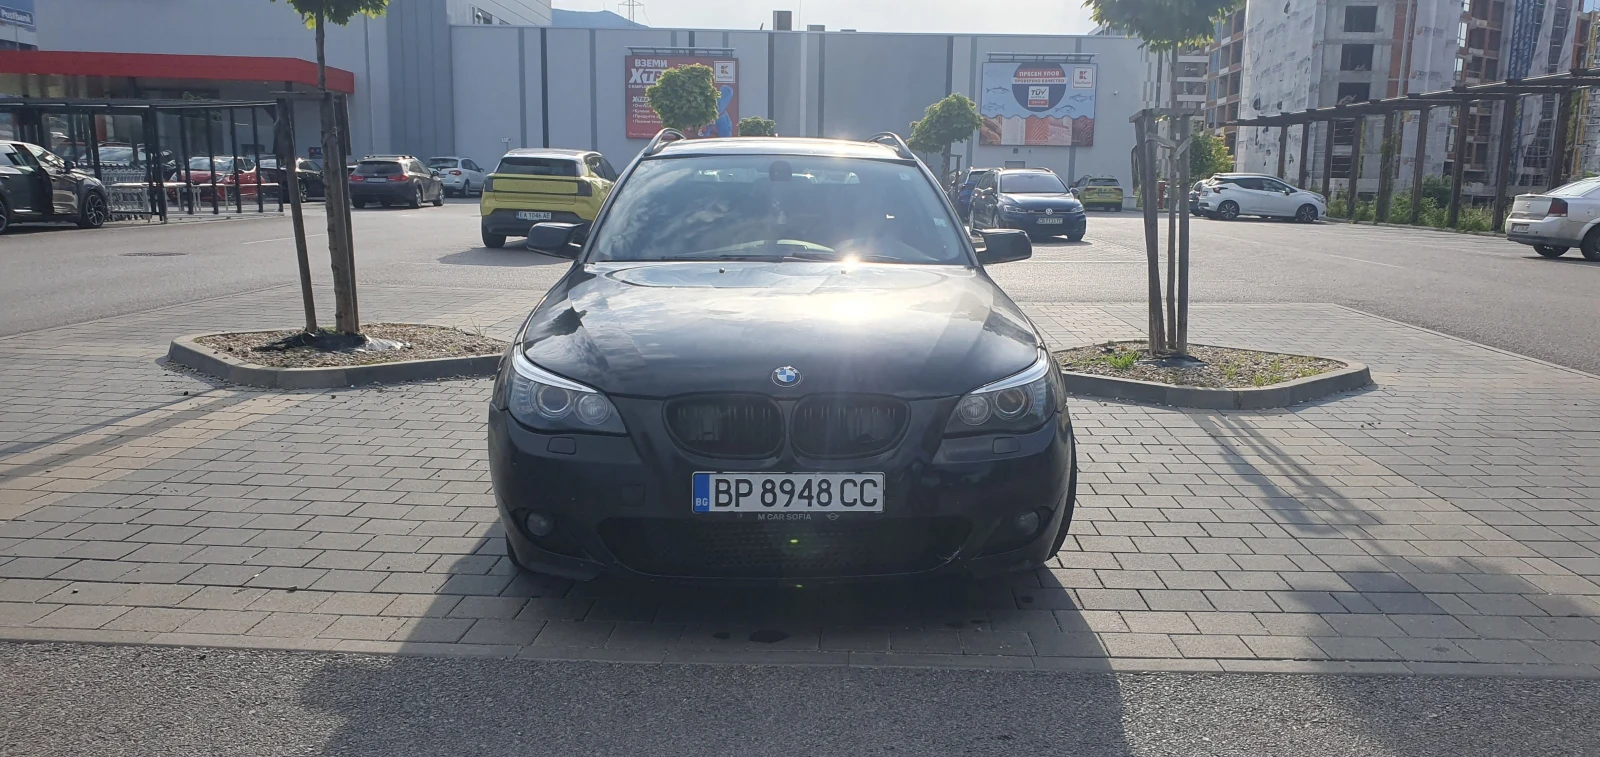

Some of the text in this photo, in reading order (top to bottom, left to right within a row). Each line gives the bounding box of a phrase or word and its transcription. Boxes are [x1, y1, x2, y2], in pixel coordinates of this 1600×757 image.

[1, 9, 32, 23] Postbank
[634, 58, 668, 68] ВЗЕМИ
[695, 478, 878, 507] BG BP 8948 CC
